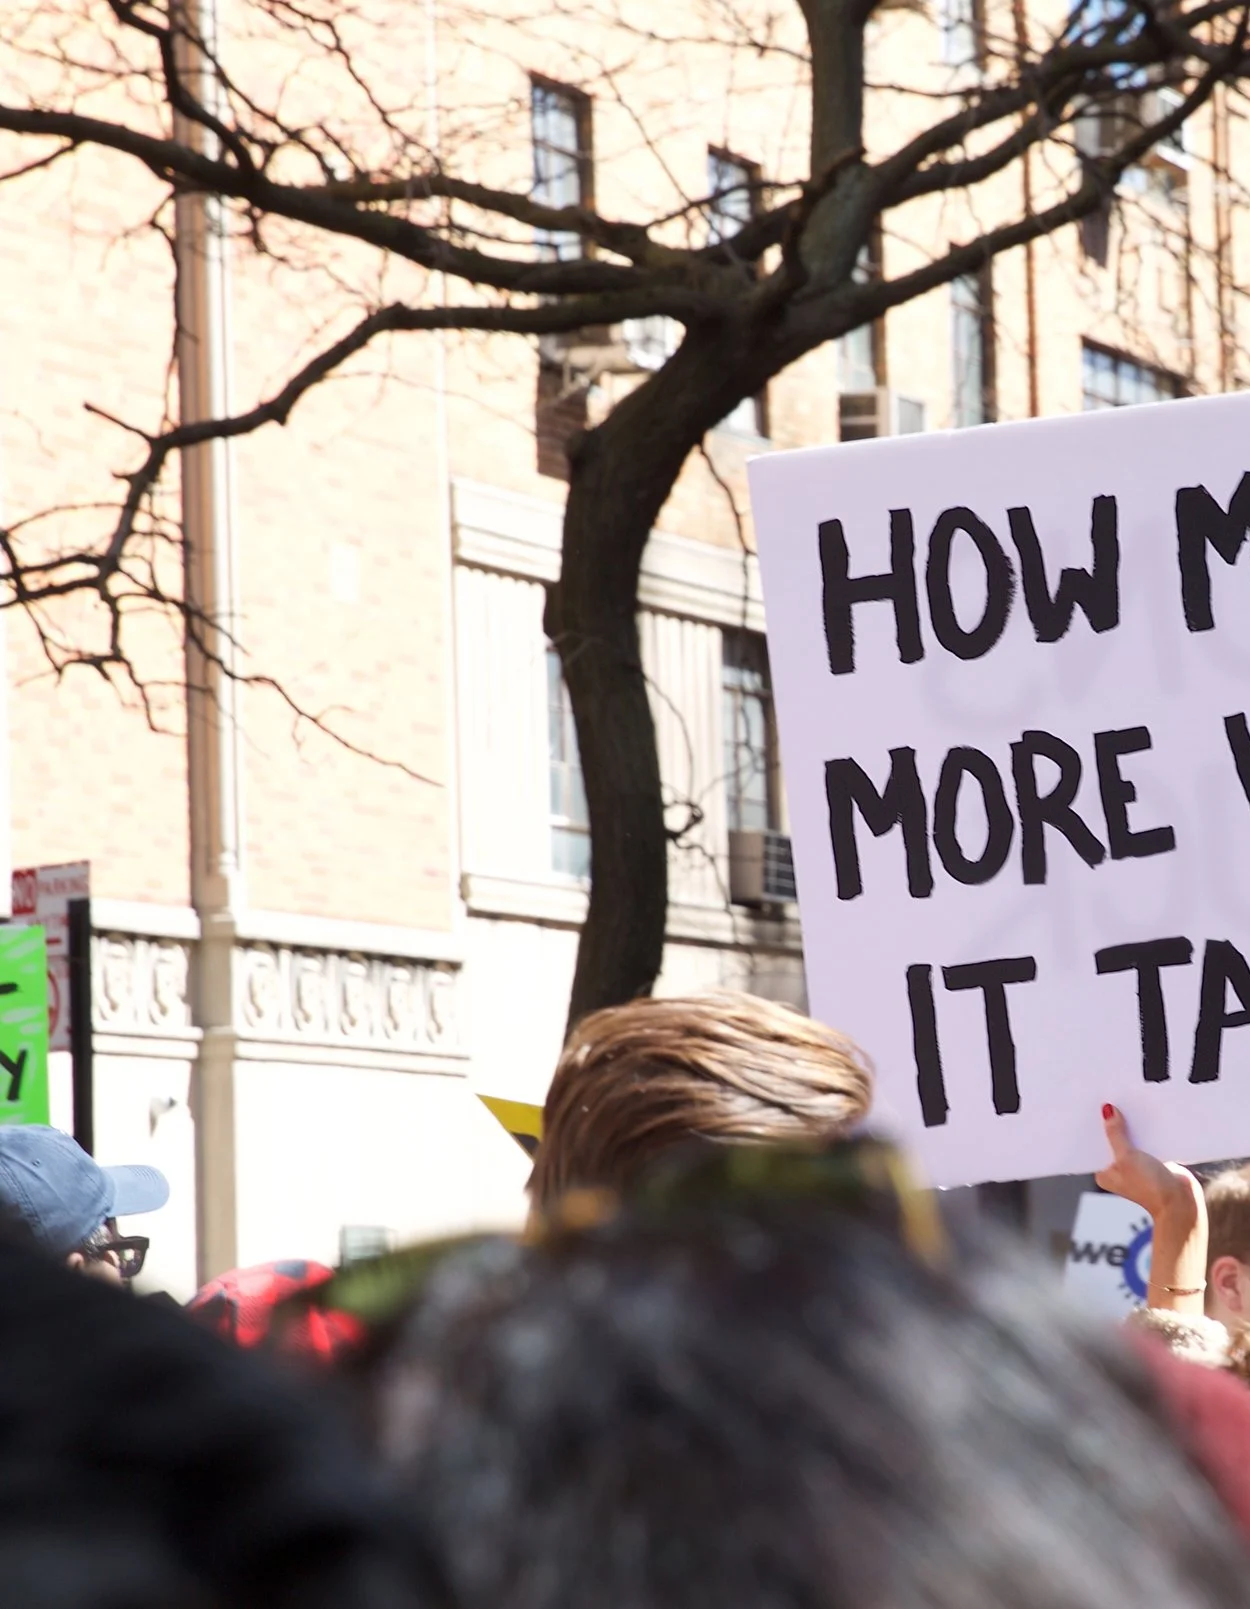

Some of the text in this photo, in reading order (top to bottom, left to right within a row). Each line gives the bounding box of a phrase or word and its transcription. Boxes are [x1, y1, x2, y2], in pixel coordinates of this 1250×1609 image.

[818, 494, 1120, 676] HOW
[825, 725, 1177, 900] MORE
[905, 955, 1037, 1128] IT
